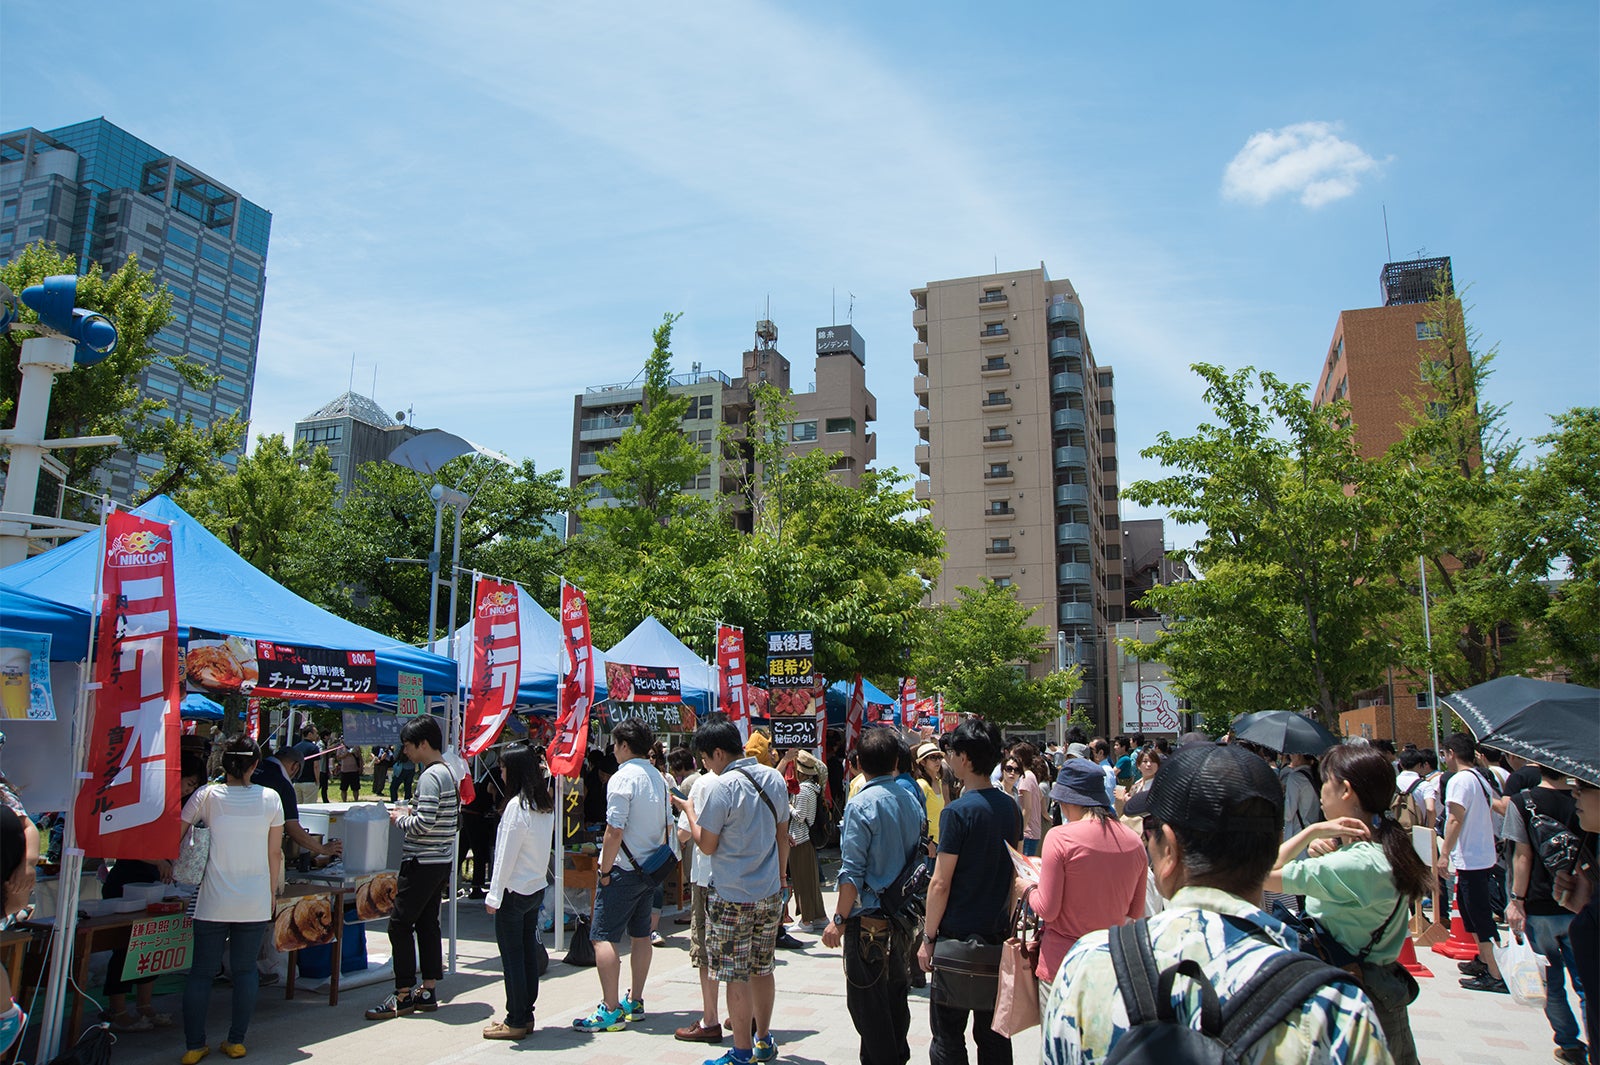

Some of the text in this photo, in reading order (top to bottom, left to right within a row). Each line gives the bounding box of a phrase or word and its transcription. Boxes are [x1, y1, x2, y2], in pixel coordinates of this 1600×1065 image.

[818, 340, 849, 350] レジデンス
[120, 551, 167, 566] NIKU ON
[769, 633, 813, 651] 最後尾
[263, 650, 270, 659] 6
[351, 653, 371, 665] 800円
[302, 664, 345, 677] 鎌倉照り焼き
[769, 658, 813, 676] 超希少
[269, 671, 371, 693] チャーシューエッグ
[770, 676, 813, 685] 牛ヒレひも肉
[29, 708, 51, 719] ¥500
[774, 721, 815, 733] ごっつい
[774, 733, 816, 744] 秘伝のタレ
[137, 946, 186, 975] ¥800
